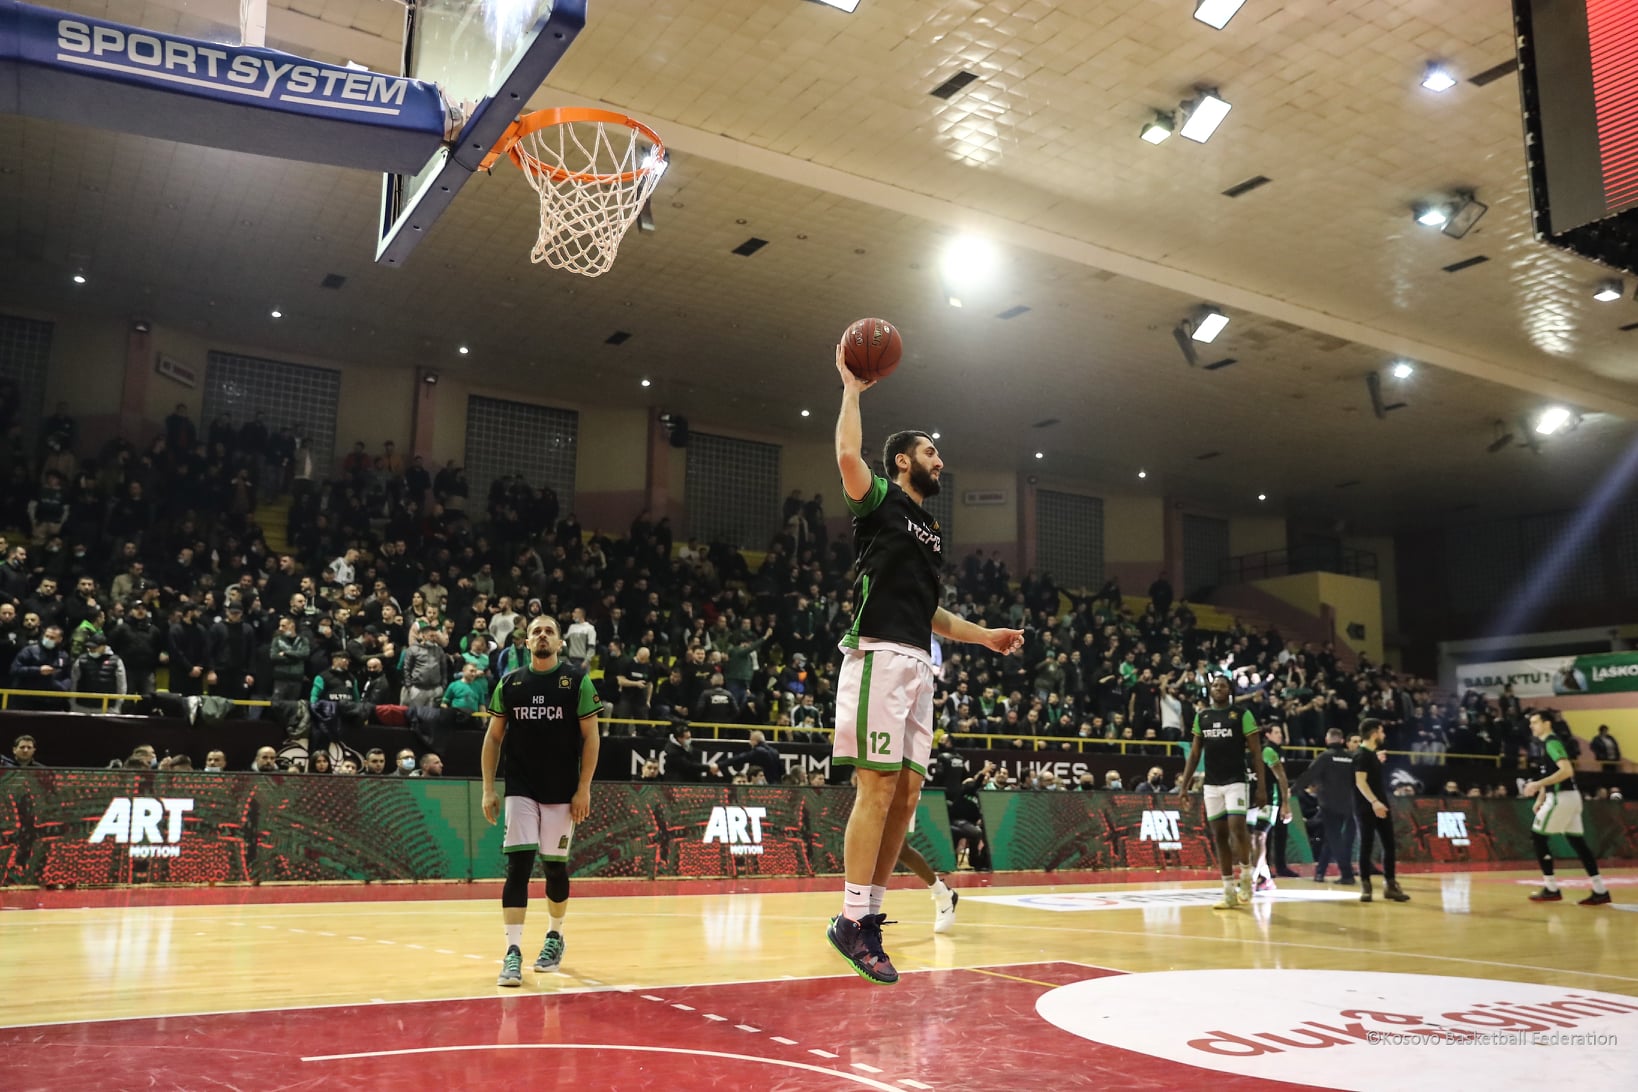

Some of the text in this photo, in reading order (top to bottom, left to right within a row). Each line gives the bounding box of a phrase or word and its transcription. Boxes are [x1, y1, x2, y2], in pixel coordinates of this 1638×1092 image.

[532, 695, 545, 704] KB
[513, 706, 564, 721] TREPÇA
[870, 731, 891, 754] 12
[1202, 728, 1233, 738] TREPÇA
[88, 797, 194, 843] ART
[702, 806, 767, 844] ART
[1139, 810, 1181, 842] ART
[129, 845, 180, 857] MOTION
